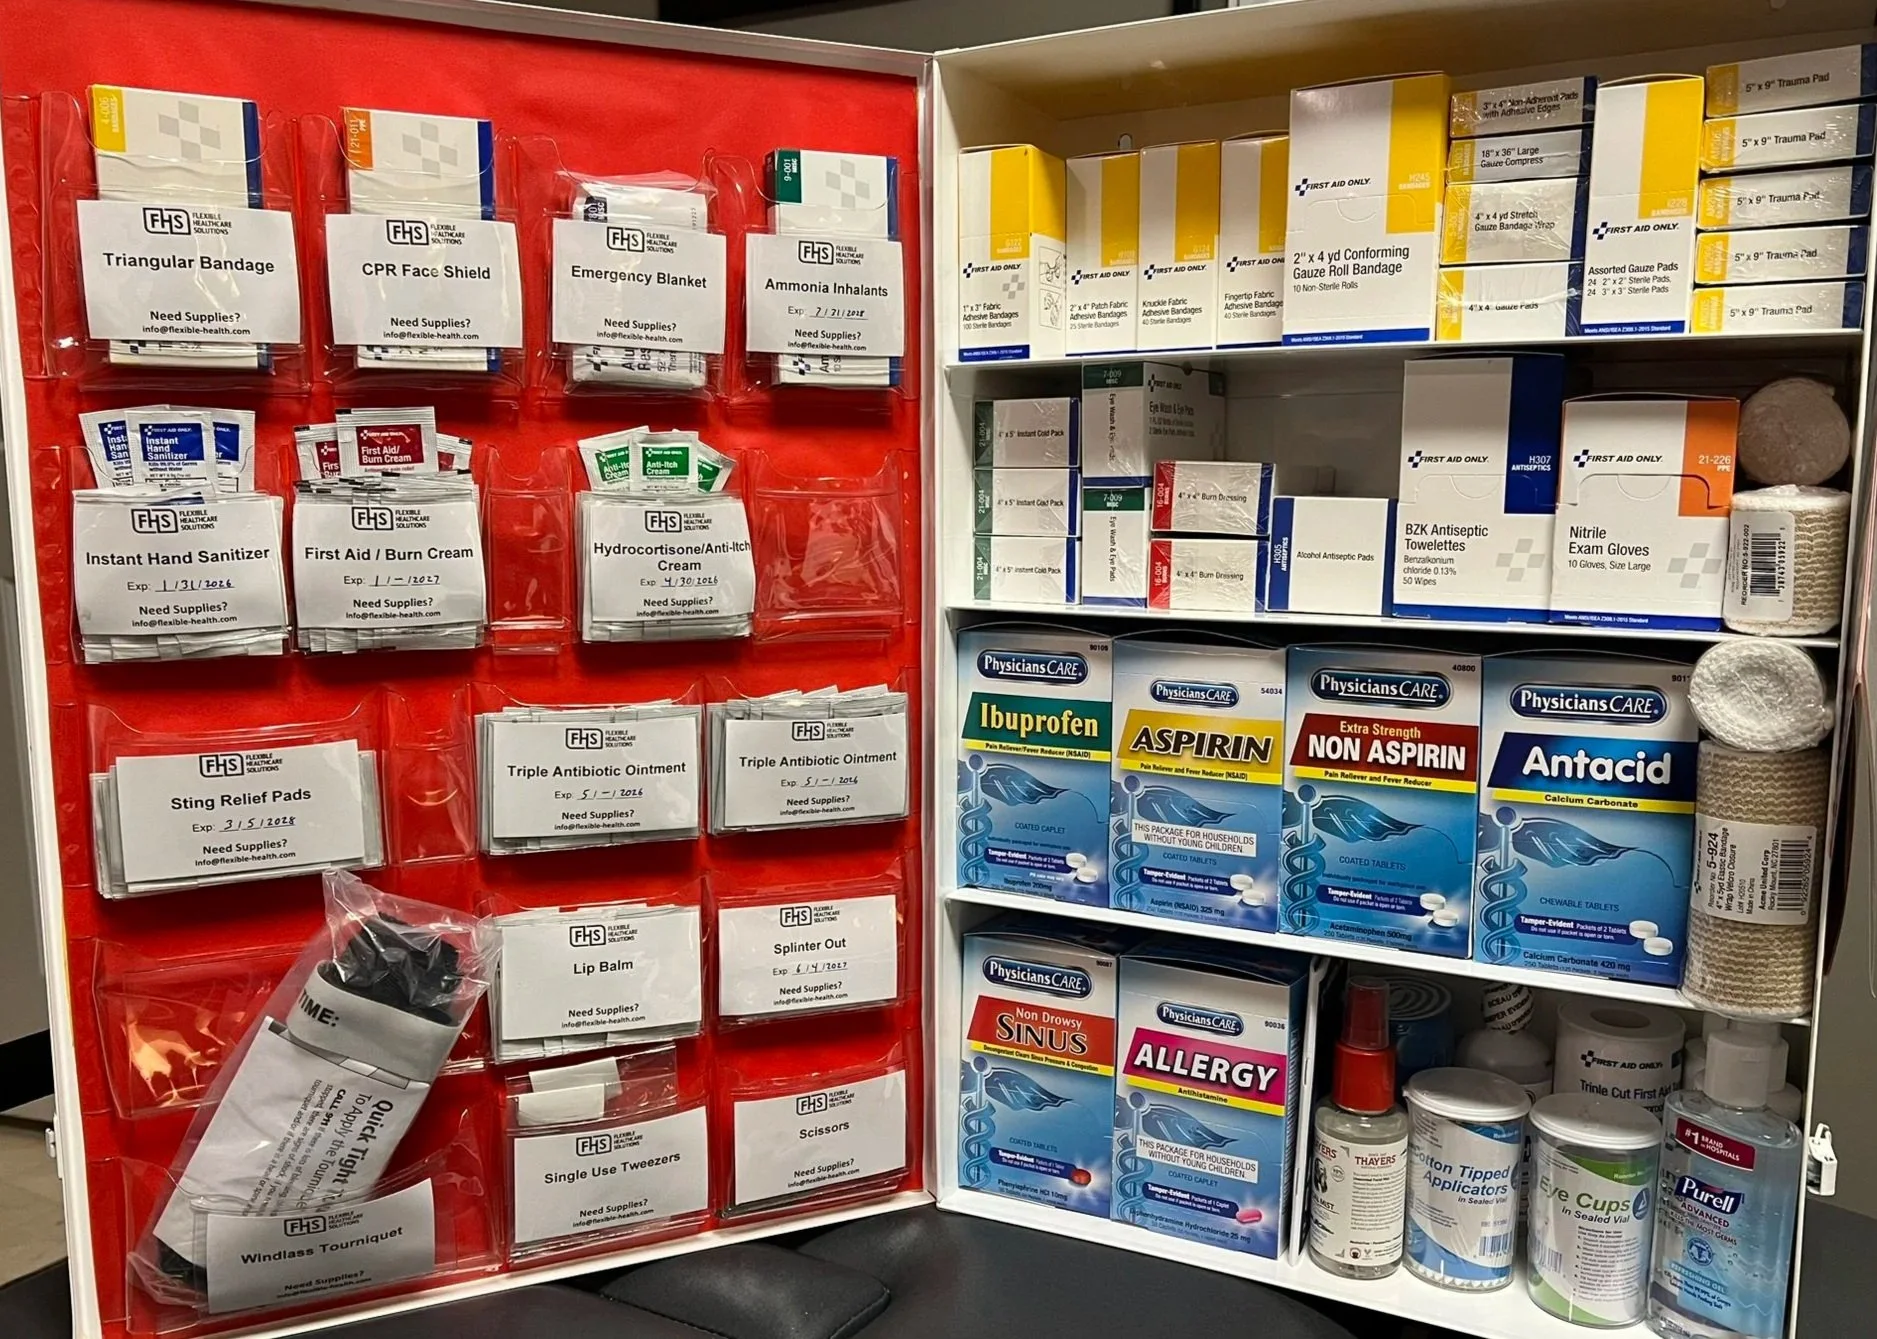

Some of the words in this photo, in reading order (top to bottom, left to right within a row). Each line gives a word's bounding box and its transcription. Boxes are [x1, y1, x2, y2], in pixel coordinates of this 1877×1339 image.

[1778, 77, 1810, 88] Trauma
[1813, 73, 1829, 82] Pad
[1517, 147, 1539, 156] Large
[1481, 159, 1503, 168] Gauze
[1504, 157, 1543, 167] Compress
[1306, 182, 1330, 190] FIRST
[1332, 180, 1346, 188] AID
[1308, 254, 1314, 263] x
[1318, 252, 1324, 262] 4
[1328, 251, 1340, 263] yd
[1344, 246, 1409, 262] Conforming
[103, 252, 194, 270] Triangular
[201, 255, 274, 273] Bandage
[1588, 264, 1626, 275] Assorted
[1628, 263, 1654, 274] Gauze
[1657, 262, 1678, 272] Pads
[362, 262, 397, 277] CPR
[402, 264, 438, 278] Face
[444, 265, 490, 279] Shield
[572, 266, 652, 286] Emergency
[657, 272, 707, 288] Blanket
[1293, 267, 1325, 279] Gauze
[1329, 265, 1349, 278] Roll
[1352, 262, 1402, 276] Bandage
[765, 278, 829, 295] Ammonia
[834, 282, 888, 297] Inhalants
[1293, 284, 1301, 292] 10
[1342, 281, 1358, 289] Rolls
[1224, 292, 1250, 302] Fingertip
[1253, 290, 1274, 299] Fabric
[150, 310, 182, 322] Need
[186, 312, 240, 324] Supplies?
[963, 312, 987, 320] Adhesive
[989, 311, 1019, 320] Bandages
[142, 325, 250, 336] info@flexible-health.com
[145, 436, 179, 445] Instant
[146, 444, 171, 452] Hand
[147, 451, 187, 460] Sanitizer
[362, 447, 381, 455] First
[362, 454, 383, 463] Burn
[385, 454, 411, 463] Cream
[1587, 454, 1613, 463] FIRST
[1615, 454, 1634, 463] AID
[646, 460, 678, 469] Anti-Itch
[1529, 455, 1551, 465] H307
[1698, 455, 1731, 465] 21-226
[1405, 524, 1427, 536] BZK
[1430, 525, 1488, 539] Antiseptic
[1570, 526, 1606, 540] Nitrile
[594, 541, 750, 556] Hydrocortisone/Anti-Itch
[1405, 538, 1465, 551] Towelettes
[1568, 542, 1604, 555] Exam
[1608, 543, 1649, 557] Gloves
[86, 551, 142, 565] Instant
[148, 550, 193, 564] Hand
[199, 547, 269, 562] Sanitizer
[305, 548, 338, 560] First
[345, 547, 369, 560] Aid
[374, 547, 380, 560] /
[386, 547, 422, 560] Burn
[427, 546, 473, 560] Cream
[1274, 544, 1282, 564] H305
[1297, 550, 1320, 560] Alcohol
[1323, 552, 1356, 562] Antiseptic
[1357, 552, 1374, 562] Pads
[1404, 555, 1454, 565] Benzalkonium
[658, 560, 701, 571] Cream
[1403, 567, 1431, 576] chloride
[1434, 568, 1456, 576] 0.13%
[1568, 560, 1577, 569] 10
[1609, 561, 1625, 570] Size
[1627, 562, 1651, 572] Large
[1403, 577, 1412, 585] 50
[1415, 577, 1436, 587] Wipes
[980, 702, 1098, 738] Ibuprofen
[1340, 721, 1369, 735] Extra
[1372, 723, 1421, 739] Strength
[1131, 727, 1274, 762] ASPIRIN
[1308, 734, 1362, 760] NON
[1368, 740, 1466, 771] ASPIRIN
[507, 765, 548, 778] Triple
[553, 764, 620, 777] Antibiotic
[626, 762, 686, 775] Ointment
[1522, 746, 1672, 784] Antacid
[171, 796, 215, 810] Sting
[220, 791, 267, 807] Relief
[272, 788, 312, 802] Pads
[1544, 794, 1583, 805] Calcium
[1587, 797, 1638, 808] Carbonate
[1015, 822, 1039, 831] COATED
[1041, 825, 1065, 834] CAPLET
[1134, 823, 1149, 833] THIS
[1151, 825, 1184, 837] PACKAGE
[1186, 829, 1200, 838] FOR
[1202, 831, 1254, 845] HOUSEHOLDS
[203, 844, 233, 854] Need
[236, 838, 287, 852] Supplies?
[1144, 833, 1176, 844] WITHOUT
[1178, 837, 1203, 848] YOUNG
[195, 850, 296, 866] info@flexible-health.com
[1707, 832, 1718, 869] 5-924
[1540, 897, 1581, 910] CHEWABLE
[1584, 901, 1619, 912] TABLETS
[1520, 916, 1574, 929] Tamper-Evident
[774, 940, 821, 955] Splinter
[824, 938, 846, 950] Out
[574, 961, 594, 975] Lip
[600, 959, 633, 973] Balm
[1524, 952, 1555, 962] Calcium
[1557, 955, 1598, 967] Carbonate
[1618, 963, 1631, 972] mg
[568, 1008, 593, 1018] Need
[596, 1004, 639, 1017] Supplies?
[1016, 1007, 1038, 1020] Non
[1042, 1012, 1082, 1029] Drowsy
[997, 1013, 1088, 1055] SINUS
[1134, 1044, 1278, 1091] ALLERGY
[329, 1090, 346, 1113] CALL
[1178, 1087, 1228, 1103] Antihistamine
[322, 1112, 334, 1126] 911
[358, 1100, 393, 1142] Quick
[799, 1121, 849, 1139] Scissors
[1684, 1128, 1698, 1145] #1
[1701, 1135, 1724, 1149] BRAND
[332, 1145, 368, 1185] Tight
[545, 1169, 587, 1184] Single
[592, 1164, 617, 1178] Use
[622, 1151, 680, 1172] Tweezers
[1355, 1154, 1396, 1166] THAYERS
[1459, 1161, 1510, 1181] Tipped
[1423, 1170, 1508, 1195] Applicators
[1539, 1175, 1570, 1202] Eye
[1576, 1192, 1631, 1213] Cups
[1681, 1178, 1735, 1213] Purell
[1562, 1207, 1571, 1216] in
[1574, 1211, 1610, 1224] Sealed
[1613, 1214, 1630, 1224] Vial
[1680, 1202, 1729, 1228] ADVANCED
[241, 1247, 314, 1265] Windlass
[320, 1226, 403, 1254] Tourniquet
